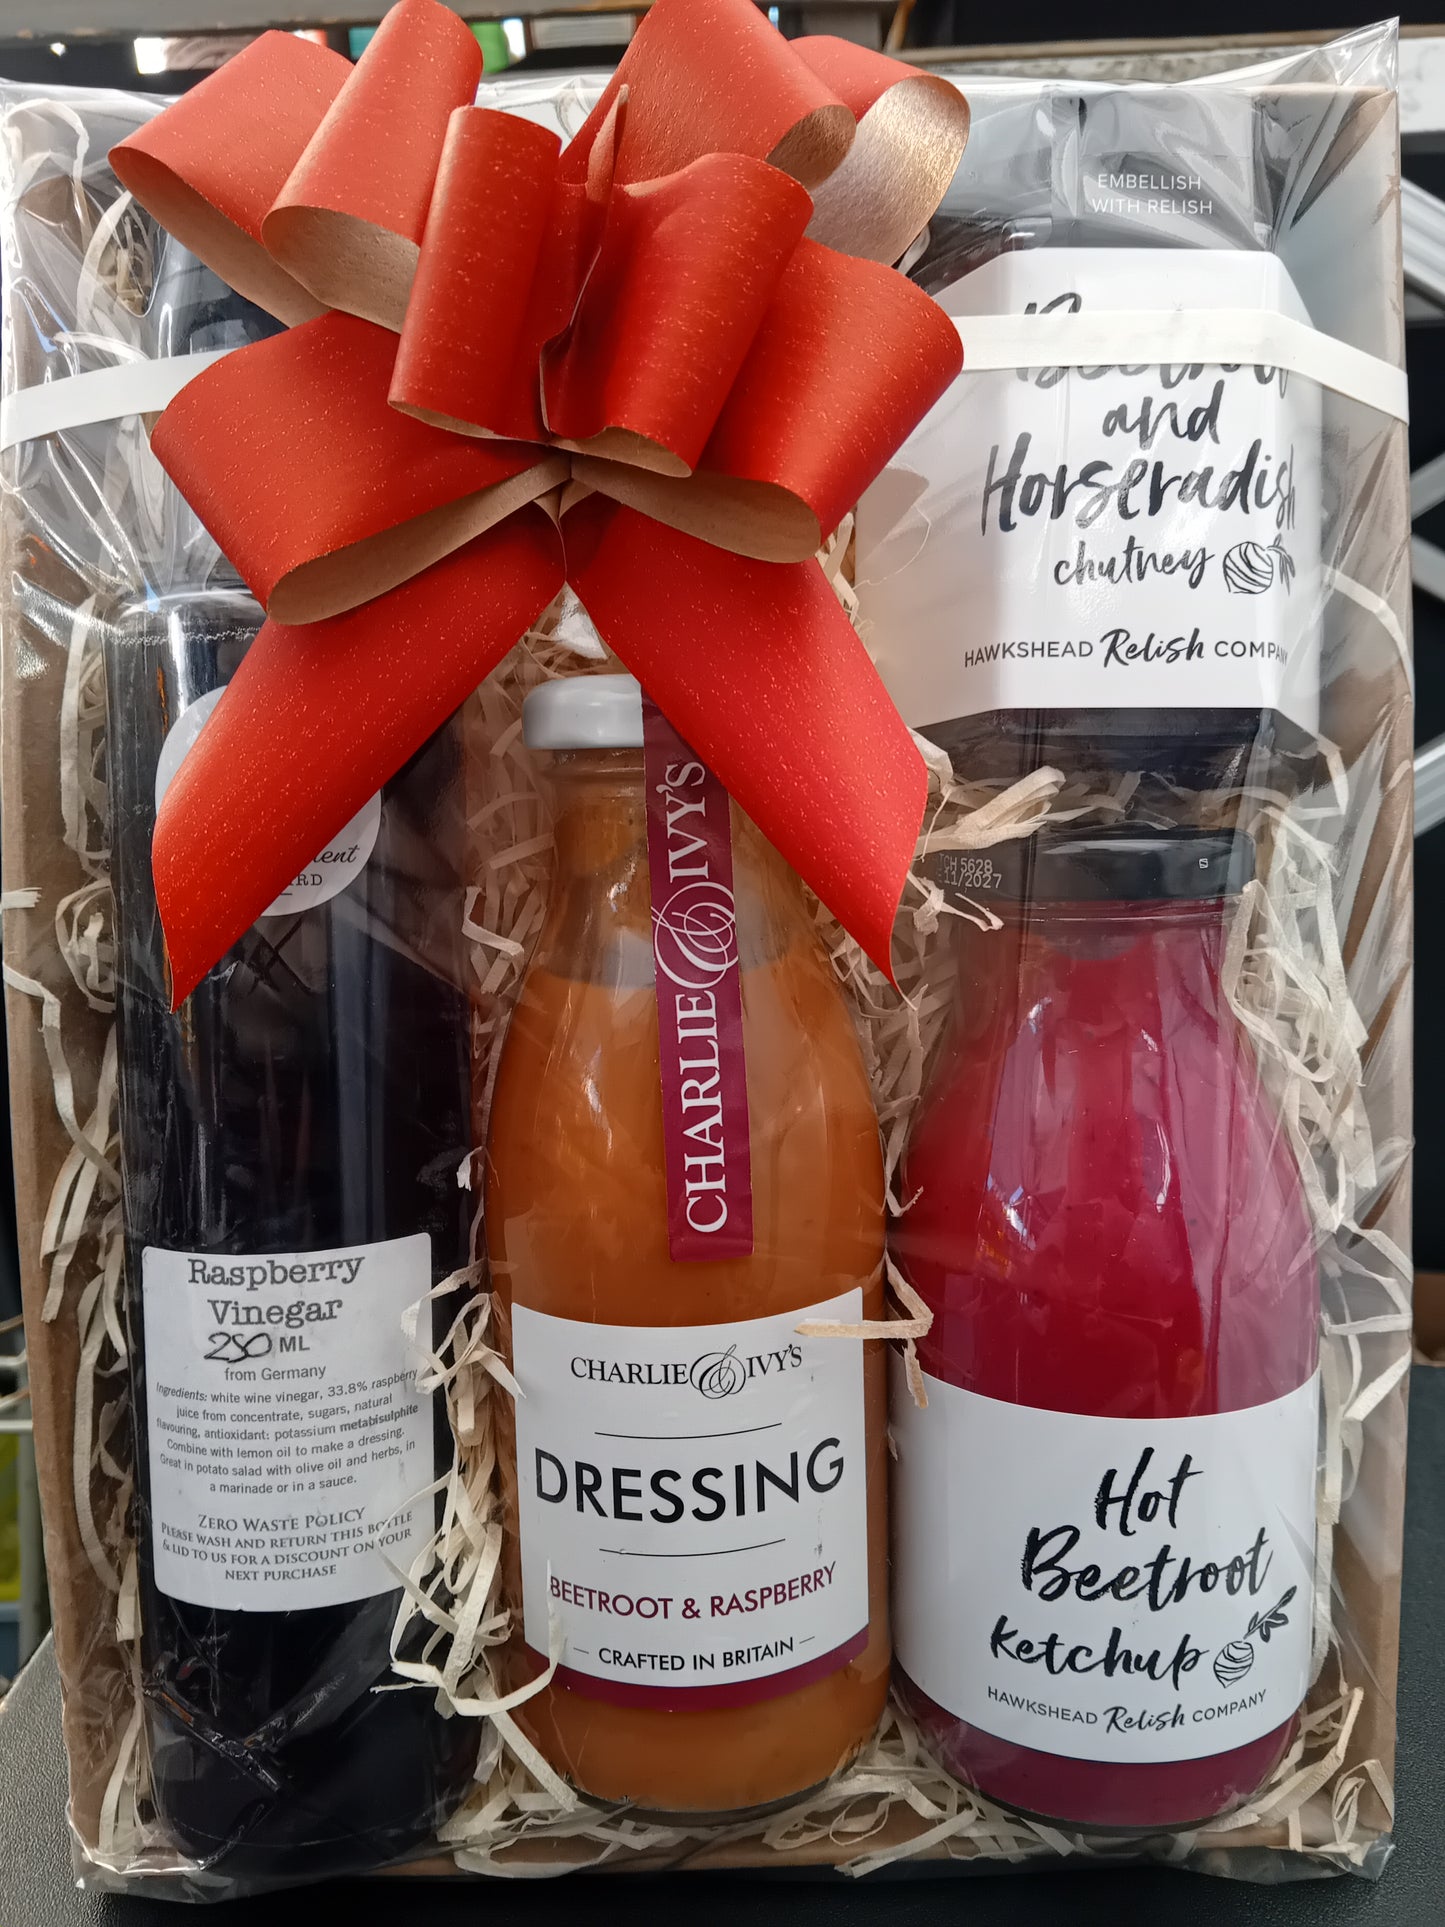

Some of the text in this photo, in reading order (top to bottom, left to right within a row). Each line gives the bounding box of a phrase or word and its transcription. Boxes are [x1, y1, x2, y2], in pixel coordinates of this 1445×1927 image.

[1097, 173, 1202, 190] EMBELLISH
[1092, 199, 1213, 215] WITH RELISH
[1102, 379, 1225, 450] and
[981, 431, 1296, 536] Horseradish
[1053, 535, 1216, 590] chutney
[964, 627, 1288, 668] HAWKSHEAD Relish COMPANY
[676, 989, 728, 1233] CHARLIE
[187, 1256, 366, 1291] Raspberry
[207, 1299, 343, 1329] Vinegar
[279, 1335, 311, 1353] ML
[156, 1368, 418, 1403] Ingredients: white wine vinegar, 33.8% raspberry
[224, 1365, 327, 1382] from Germany
[570, 1356, 689, 1386] CHARLIE
[176, 1392, 393, 1423] juice from concentrate, sugars, natural
[204, 1427, 270, 1441] antioxidant:
[274, 1424, 336, 1442] potassium
[339, 1403, 420, 1433] metabisulphite
[160, 1440, 416, 1477] Great in potato salad with olive oil and herbs, in
[166, 1426, 406, 1459] Combine with lemon oil to make a dressing.
[209, 1475, 358, 1495] a marinade or in a sauce.
[535, 1437, 845, 1524] DRESSING
[1094, 1446, 1205, 1537] Hot
[161, 1521, 194, 1543] PLEASE
[196, 1533, 232, 1549] WASH
[234, 1538, 266, 1550] AND
[270, 1533, 327, 1549] RETURN
[330, 1526, 364, 1543] THIS
[198, 1506, 366, 1533] ZERO WASTE POLICY
[162, 1528, 413, 1566] & LID TO US FOR A DISCOUNT ON YOUR
[225, 1564, 337, 1581] NEXT PURCHASE
[1020, 1524, 1274, 1612] Beetroot
[550, 1561, 837, 1620] BEETROOT & RASPBERRY
[598, 1635, 795, 1671] CRAFTED IN BRITAIN
[987, 1685, 1268, 1734] HAWKSHEAD Relish COMPANY
